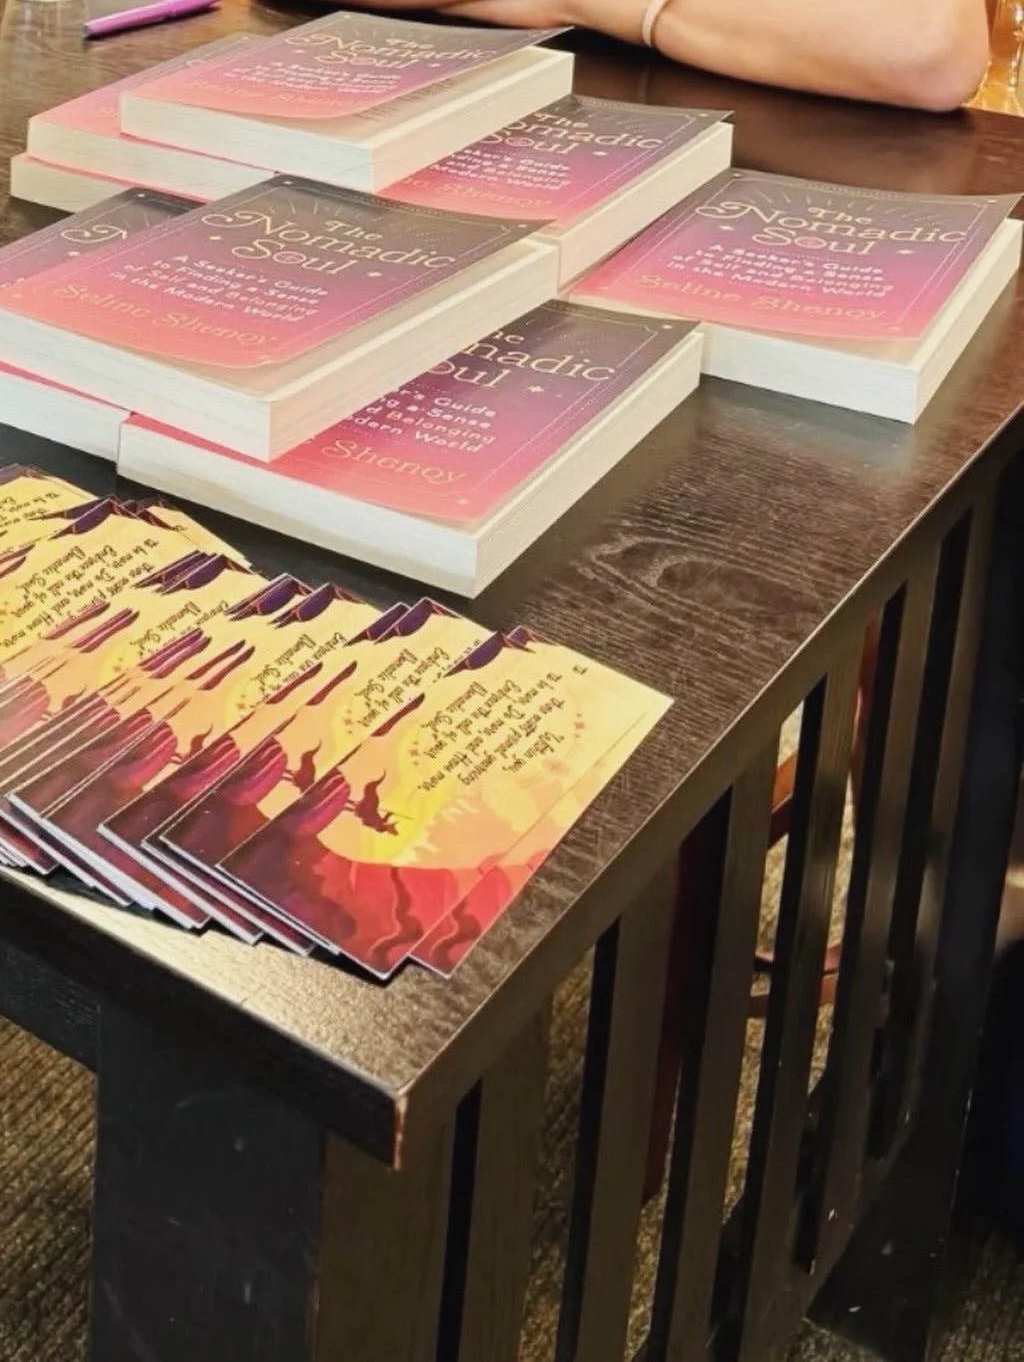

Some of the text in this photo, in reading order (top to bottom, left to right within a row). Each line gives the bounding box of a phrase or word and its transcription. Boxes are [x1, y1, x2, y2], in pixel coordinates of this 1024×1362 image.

[497, 120, 664, 149] omadic
[534, 112, 589, 129] The
[324, 219, 383, 241] The
[694, 200, 967, 244] Nomadic
[807, 205, 873, 226] The
[201, 209, 457, 270] Nomadic
[752, 226, 876, 255] Soul
[231, 239, 358, 276] Soul
[672, 254, 895, 292] of Self and Belonging
[695, 249, 717, 258] to
[722, 254, 796, 275] Finding
[822, 270, 885, 282] Sense
[709, 243, 884, 274] A Seeker's Guide
[152, 259, 172, 270] to
[175, 266, 242, 290] Finding
[264, 287, 320, 305] Sense
[173, 254, 329, 297] A Seeker's Guide
[667, 261, 888, 299] in the Modern World
[109, 271, 305, 323] in the Modern World
[147, 269, 189, 284] Self
[187, 281, 225, 295] and
[225, 291, 320, 317] Belonging
[632, 274, 889, 320] Seline Shenoy
[53, 283, 279, 346] Seline Shenoy
[424, 359, 512, 389] oul
[459, 341, 616, 382] madic
[405, 404, 493, 429] a Sense
[433, 396, 498, 418] Guide
[386, 410, 498, 445] Belonging
[414, 430, 486, 453] World
[320, 438, 469, 486] Shenoy
[41, 544, 87, 576] Nomadic
[156, 600, 202, 632] Nomadic
[275, 633, 317, 666] Nomadic
[378, 648, 418, 682] Nomadic
[446, 680, 488, 714] Nomadic
[536, 679, 554, 691] be
[423, 679, 522, 760] Embrace the call of your
[503, 704, 526, 720] Do
[442, 750, 473, 773] Have
[465, 736, 484, 756] and
[457, 749, 497, 786] yearning
